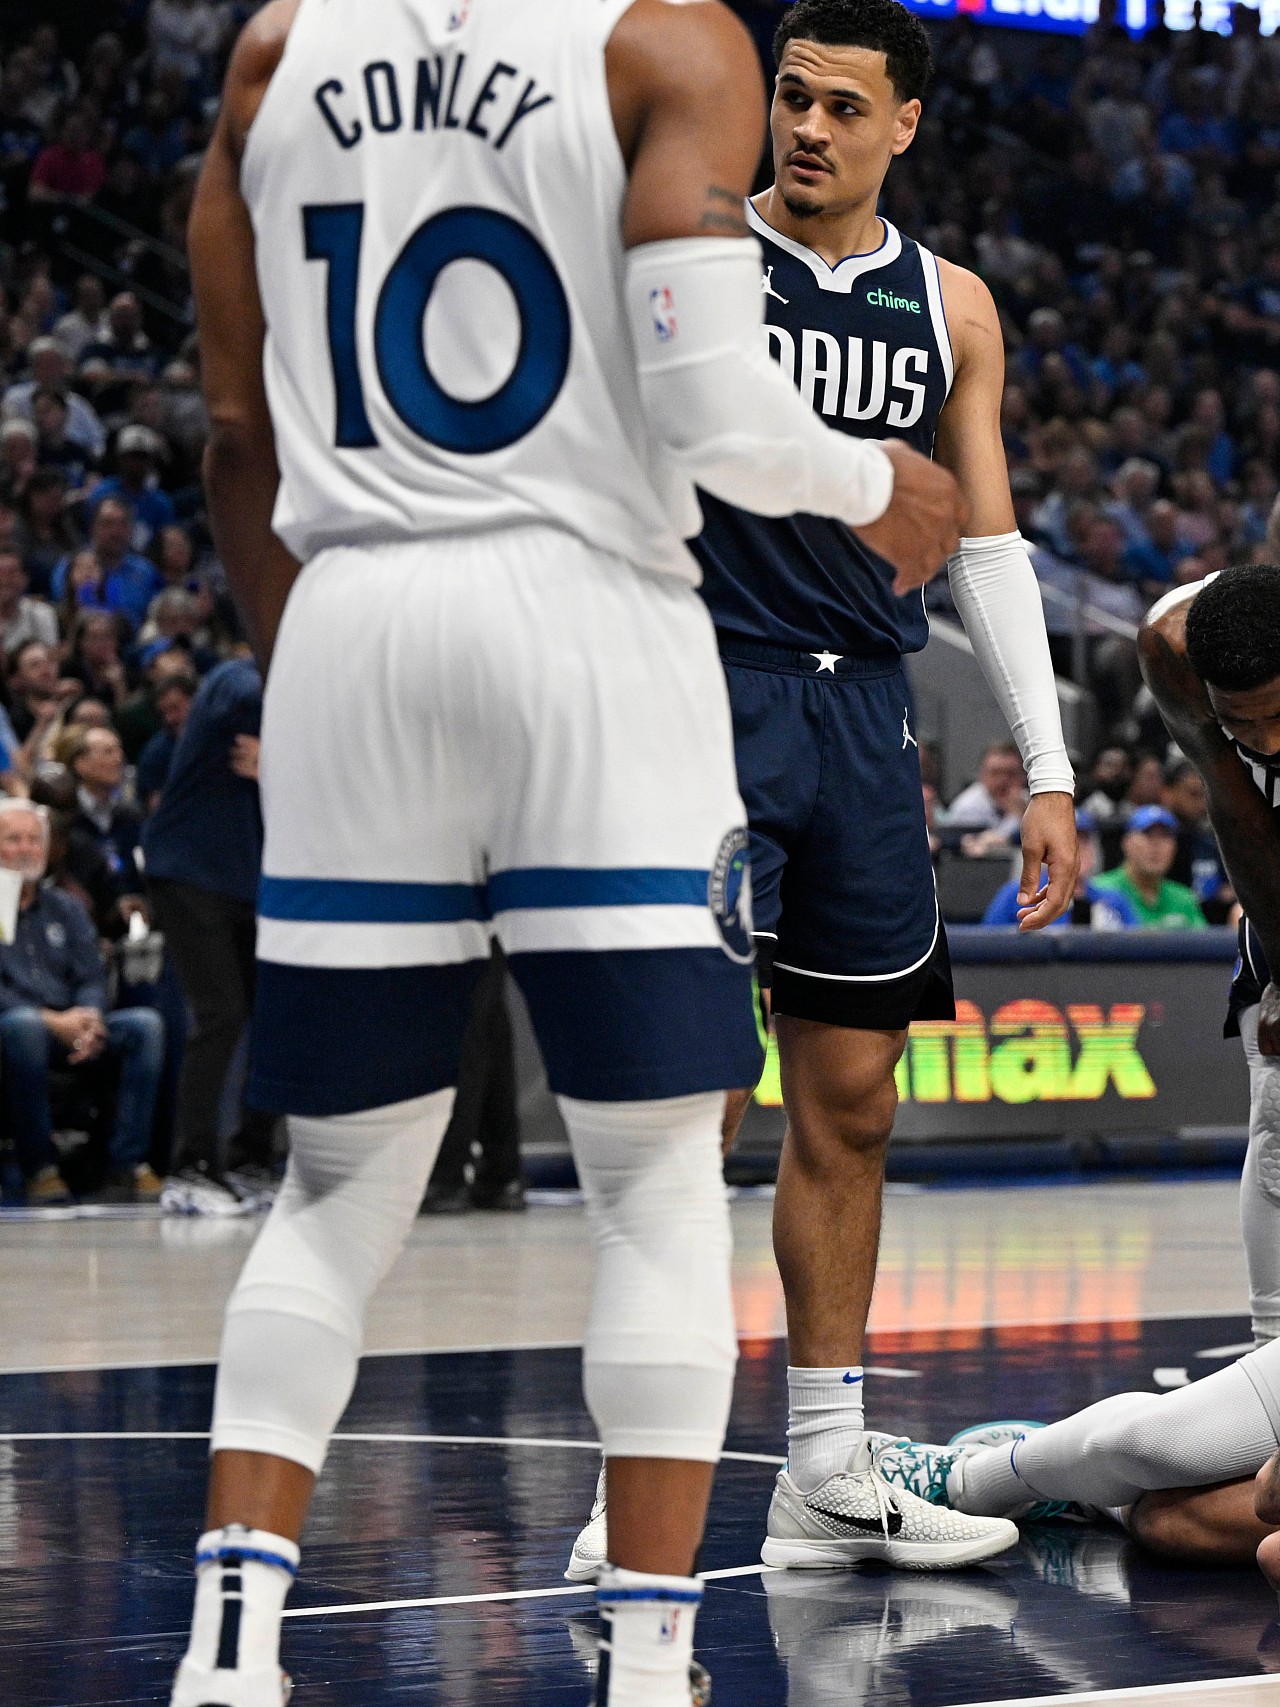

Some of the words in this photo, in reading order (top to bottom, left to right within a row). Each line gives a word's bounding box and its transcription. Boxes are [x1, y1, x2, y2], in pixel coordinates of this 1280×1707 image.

[314, 53, 555, 150] CONLEY
[302, 202, 572, 455] 10
[866, 288, 922, 314] chime
